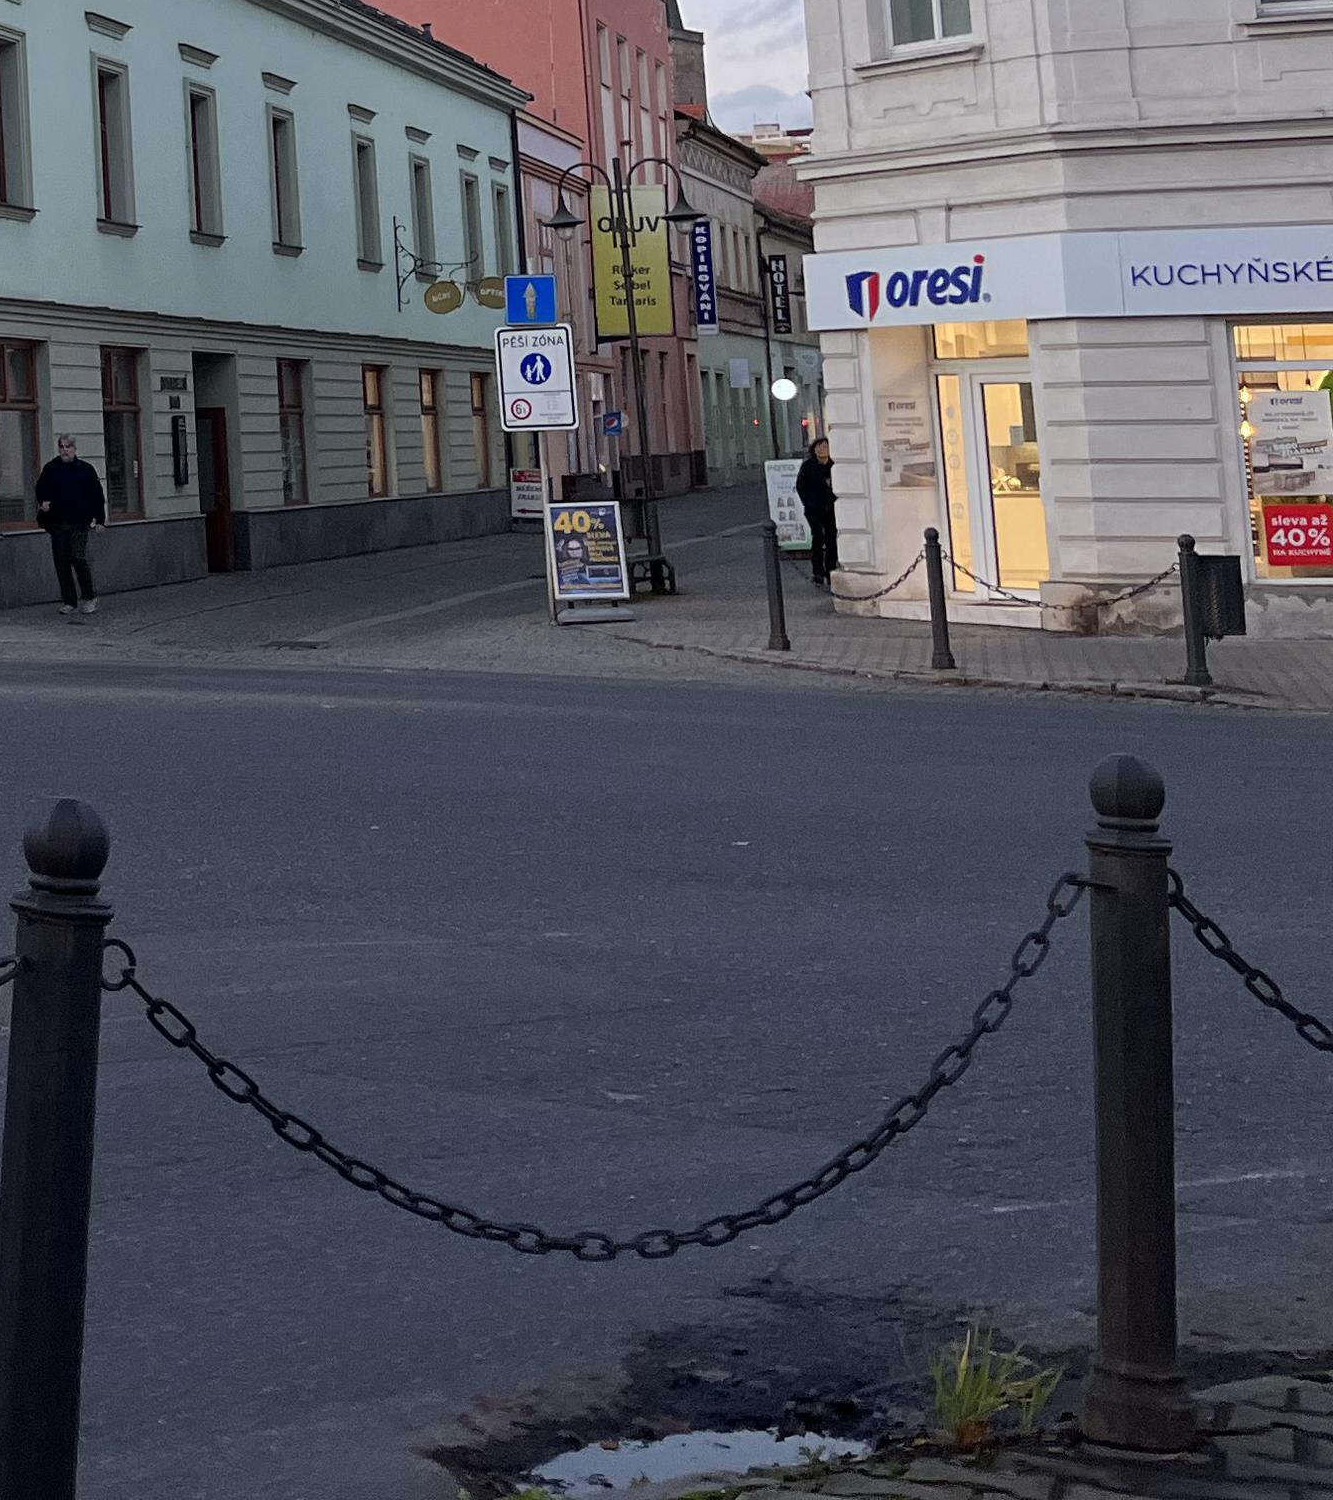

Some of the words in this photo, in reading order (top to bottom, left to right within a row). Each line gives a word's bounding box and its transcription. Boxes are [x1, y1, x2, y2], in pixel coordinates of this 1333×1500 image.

[886, 254, 985, 308] oresi
[1131, 255, 1333, 287] KUCHYŇSKÉ
[771, 260, 787, 321] HOTEL
[502, 334, 528, 349] PĚŠÍ
[533, 334, 564, 348] ZÓNA
[1271, 515, 1308, 526] sleva
[1311, 514, 1328, 526] až
